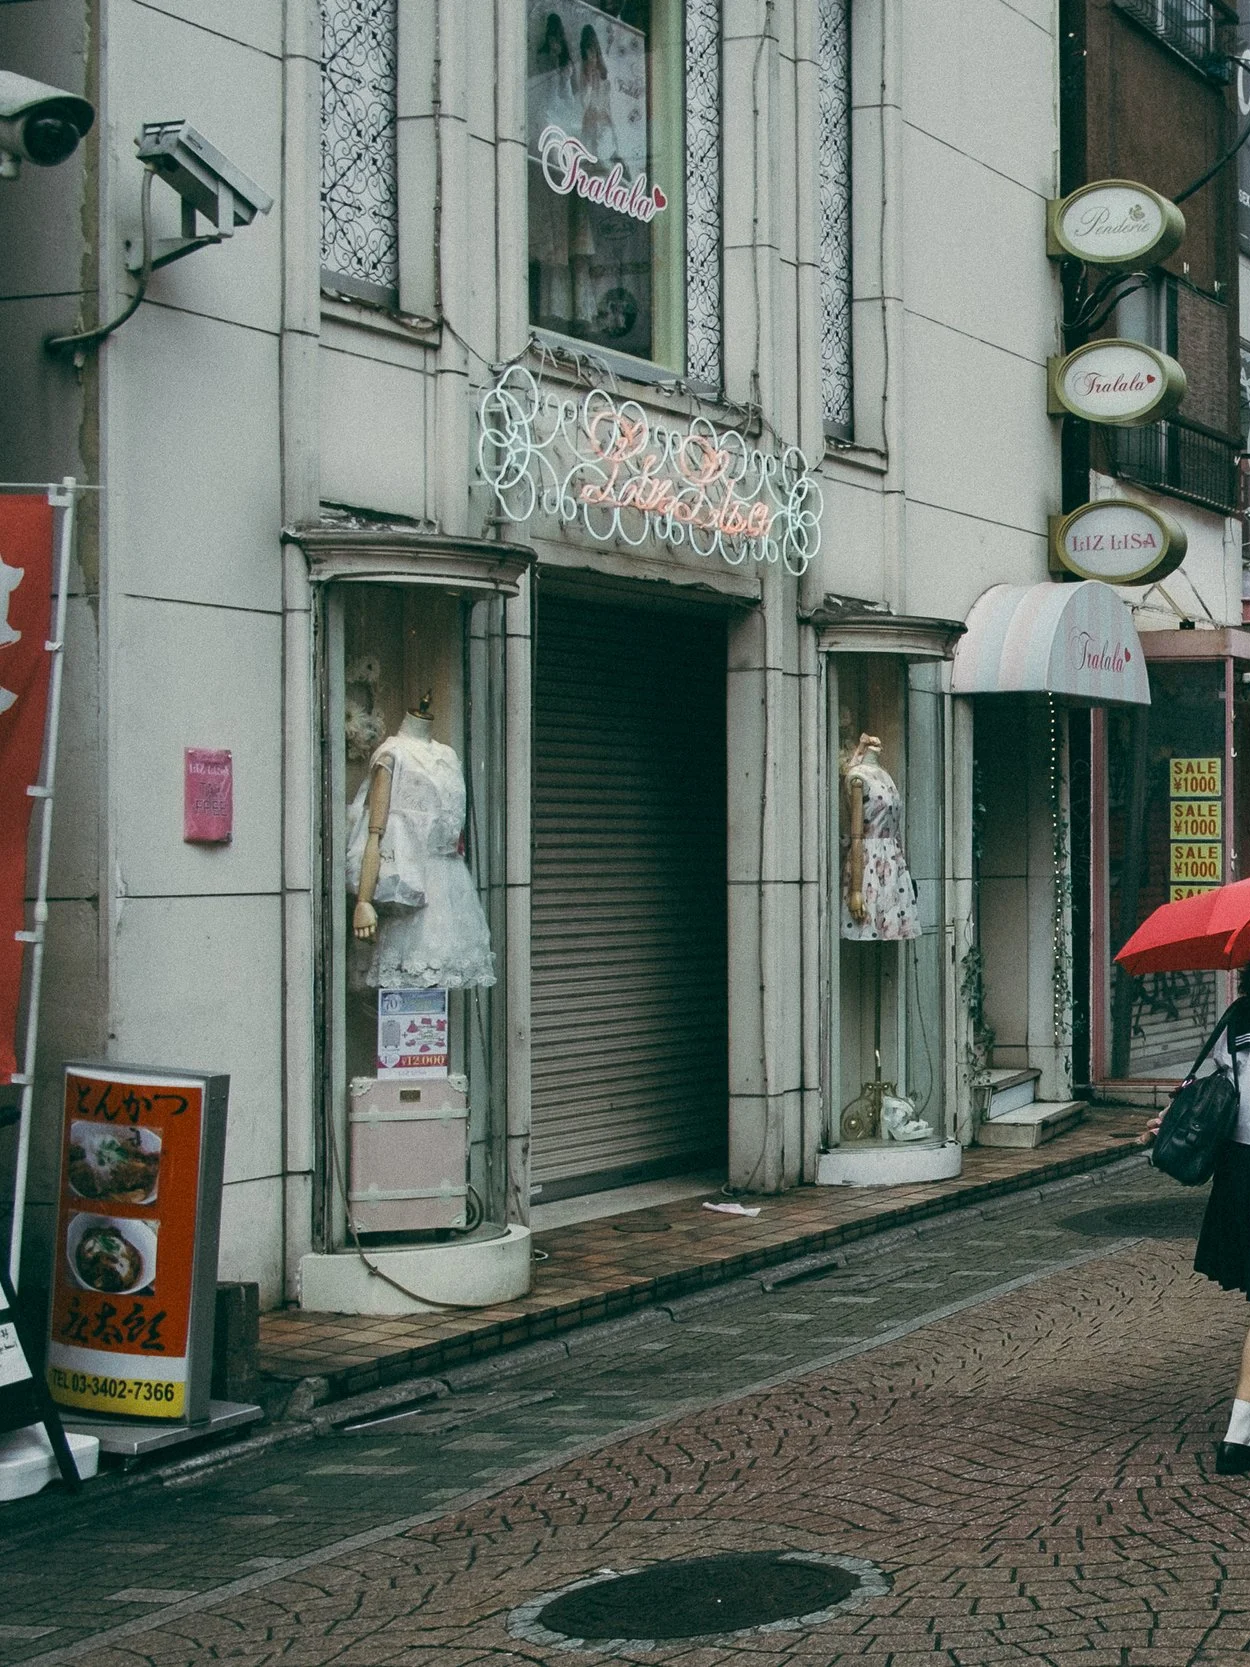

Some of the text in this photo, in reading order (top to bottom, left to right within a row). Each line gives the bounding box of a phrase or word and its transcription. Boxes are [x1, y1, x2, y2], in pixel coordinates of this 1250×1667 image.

[538, 125, 662, 223] Tralala
[1075, 206, 1150, 236] Penderie
[1072, 371, 1148, 396] Tralala
[1072, 533, 1158, 552] LIZ LISA
[1069, 626, 1125, 673] Tralala
[1174, 761, 1217, 775] SALE
[1173, 776, 1216, 793] ¥1000
[1174, 804, 1217, 817] SALE
[1173, 819, 1217, 836] ¥1000
[1174, 846, 1218, 859] SALE
[1174, 861, 1217, 878] ¥1000
[1174, 888, 1216, 901] SA
[76, 1083, 189, 1123] とんかつ
[52, 1368, 175, 1402] TEL 03-3402-7366
